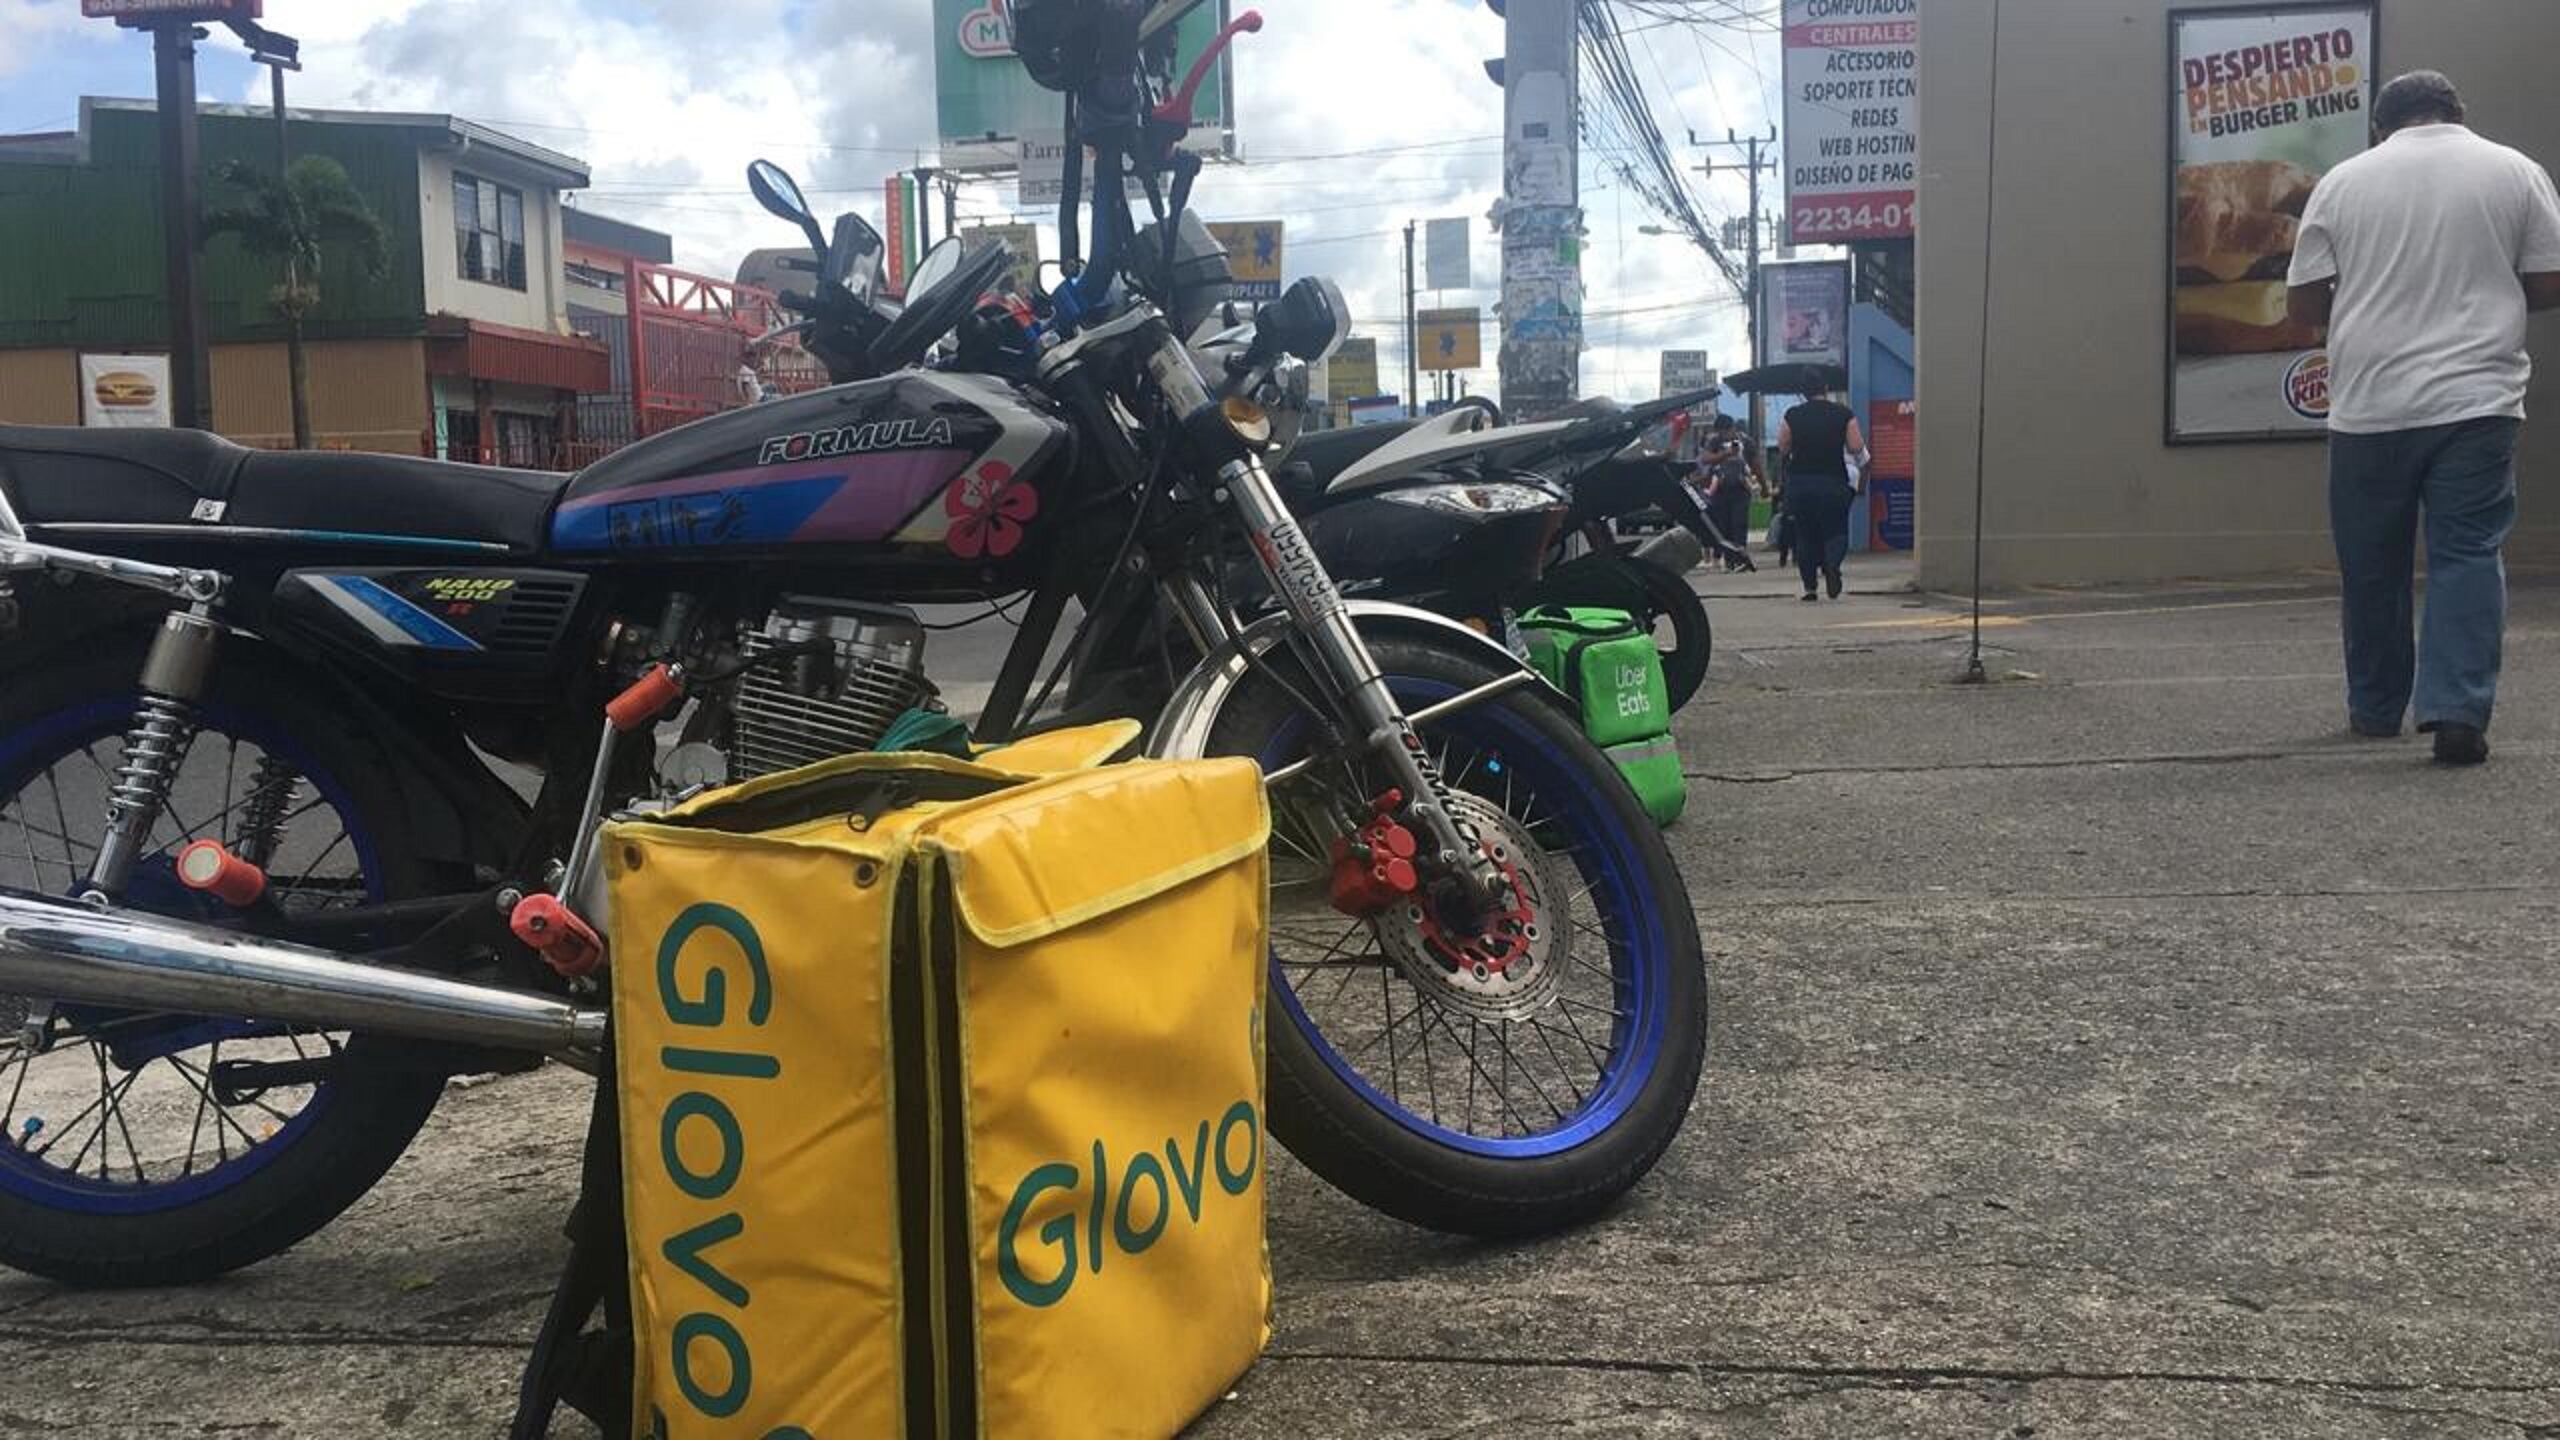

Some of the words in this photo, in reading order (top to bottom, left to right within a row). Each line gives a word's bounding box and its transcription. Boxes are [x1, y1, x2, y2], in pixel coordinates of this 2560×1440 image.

[2183, 28, 2353, 89] DESPIERTO
[1803, 80, 1875, 102] SOPORTE
[1851, 107, 1899, 128] REDES
[2209, 102, 2298, 138] BURGER
[2306, 90, 2360, 119] KING
[1820, 137, 1853, 157] WEB
[1795, 160, 1854, 187] DISEÑO
[1858, 164, 1878, 182] DE
[757, 417, 953, 465] FORMULA
[425, 578, 516, 590] NANO
[1615, 665, 1647, 689] Uber
[1617, 691, 1650, 717] Eats
[656, 902, 781, 1418] Glovo
[1000, 1100, 1257, 1307] Glovo
